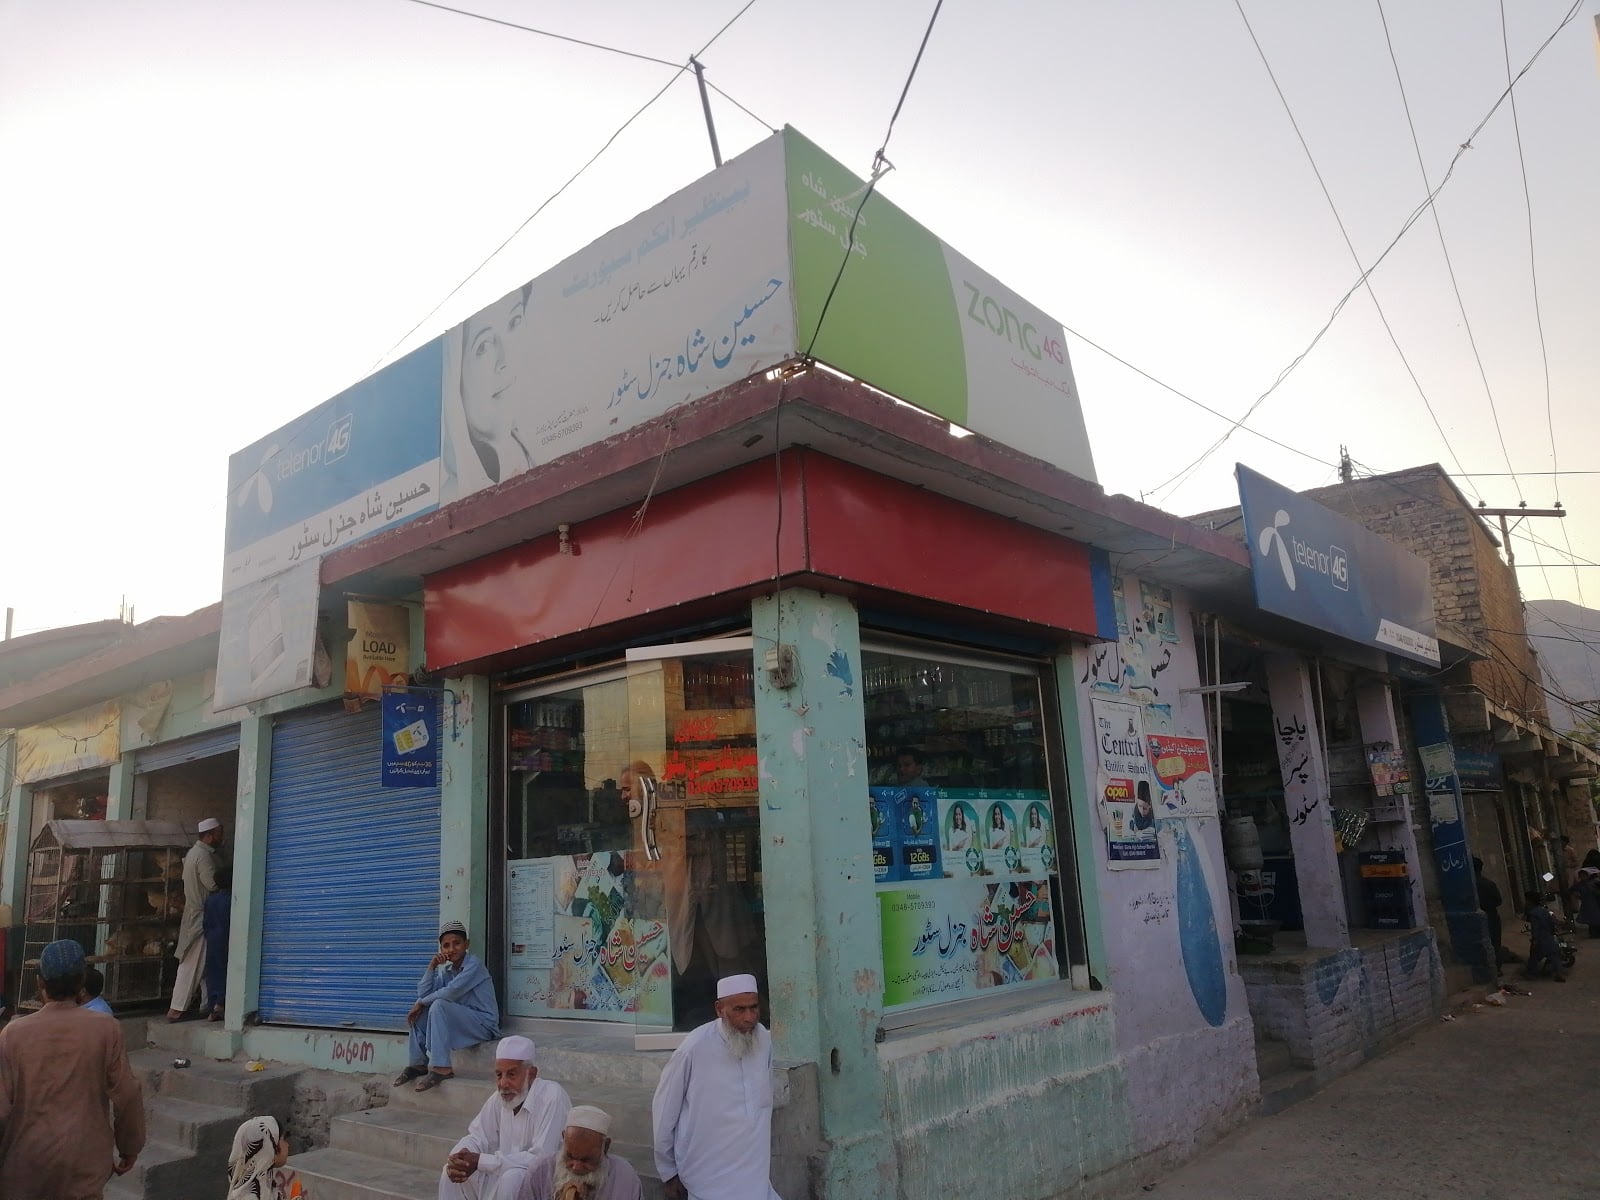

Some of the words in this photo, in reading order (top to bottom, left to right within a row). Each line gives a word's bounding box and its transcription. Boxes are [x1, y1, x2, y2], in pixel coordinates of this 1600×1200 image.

[712, 278, 784, 369] حسین
[676, 328, 710, 378] شاہ
[1043, 336, 1065, 365] 4G
[606, 369, 638, 410] سٹور
[637, 353, 671, 400] جنرل
[277, 440, 325, 480] telenor
[328, 422, 351, 454] 4G
[359, 492, 383, 523] شاہ
[386, 481, 431, 520] حسین
[288, 522, 320, 560] سٹور
[322, 513, 357, 547] جنرل
[1293, 535, 1330, 576] telenor
[1332, 556, 1347, 582] 4G
[362, 640, 397, 655] LOAD
[1101, 733, 1144, 757] Central
[1277, 714, 1306, 746] باچا
[1106, 787, 1129, 800] open
[1293, 794, 1318, 826] سٹور
[873, 854, 887, 865] GBs
[912, 922, 941, 953] سٹور
[938, 913, 967, 954] جنرل
[970, 904, 997, 950] شاہ
[996, 890, 1037, 952] حسین
[551, 934, 575, 960] سٹور
[573, 932, 599, 966] جنرل
[599, 931, 623, 965] شاہ
[624, 921, 665, 971] حسین
